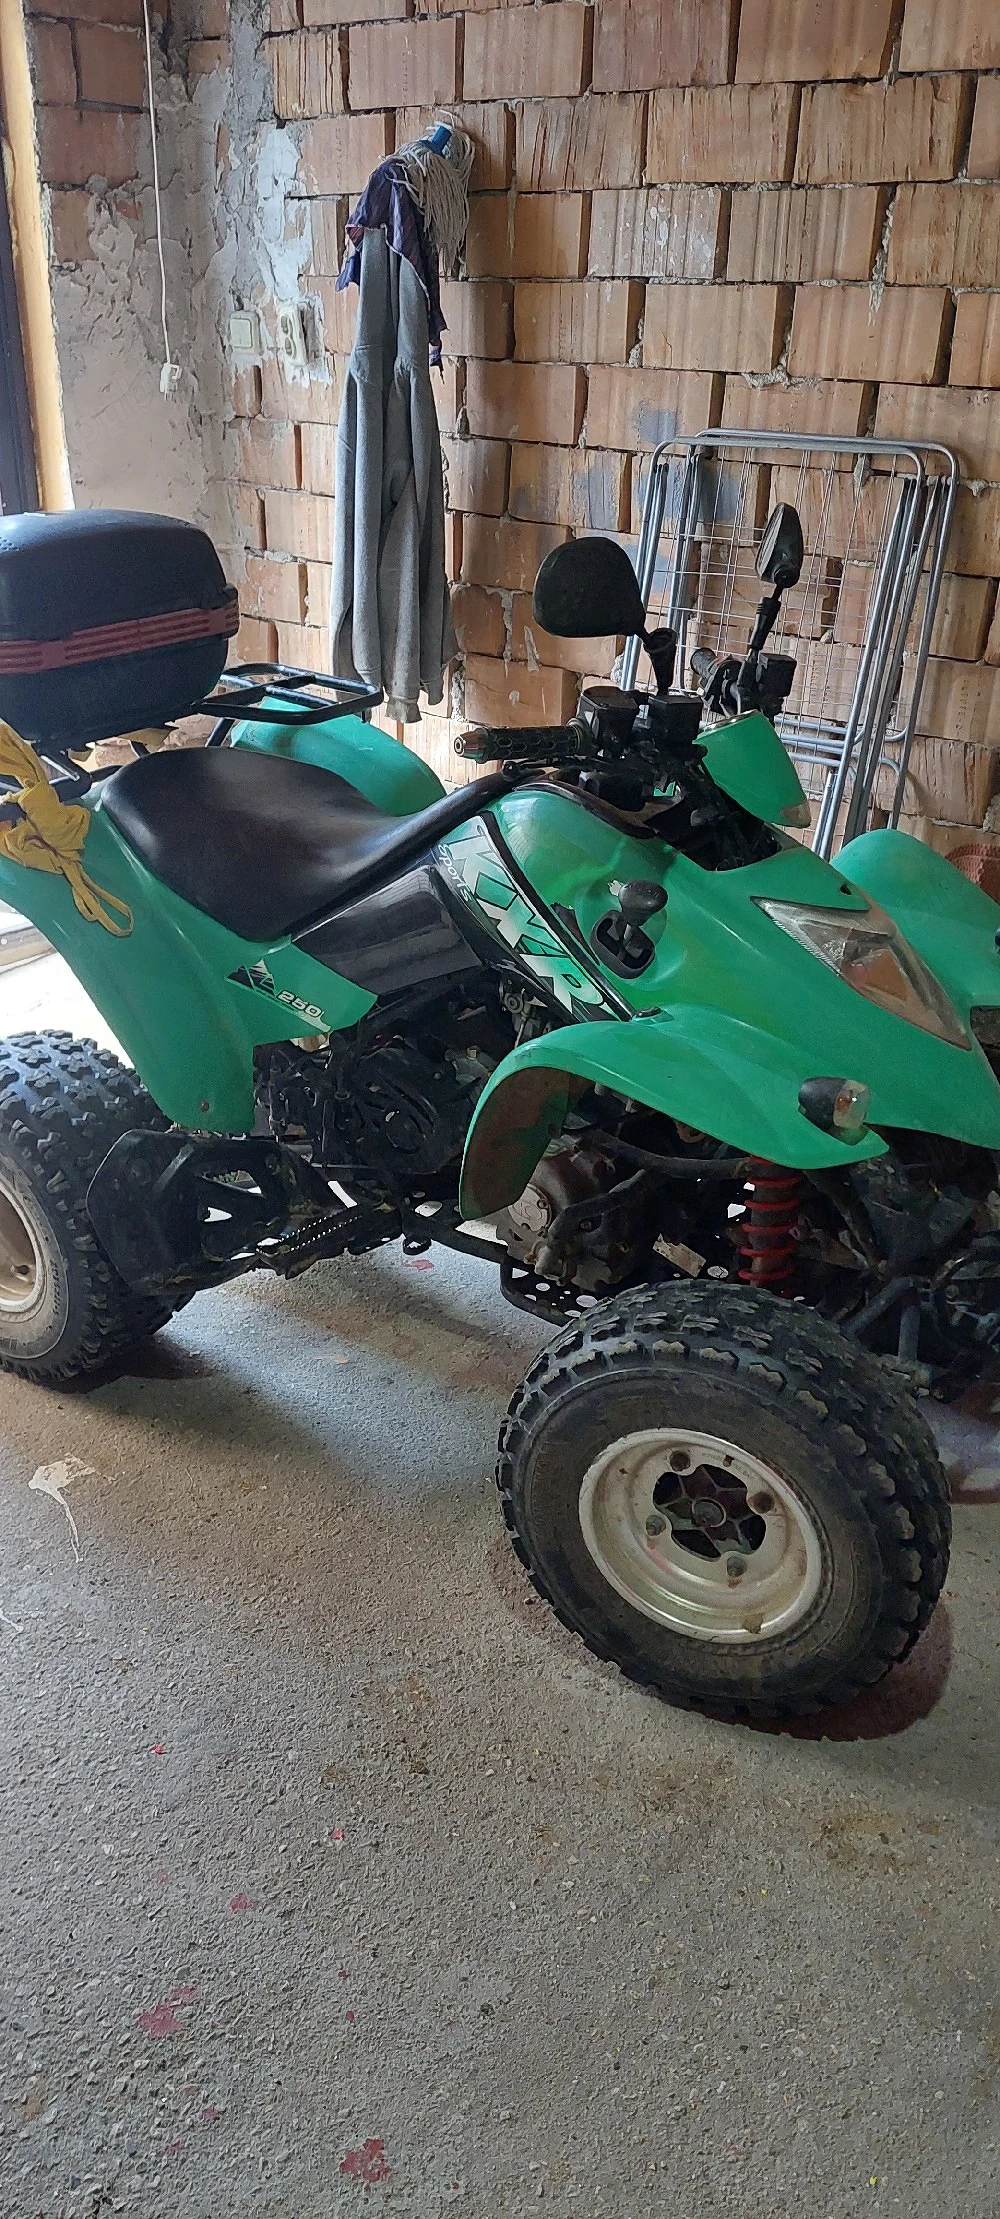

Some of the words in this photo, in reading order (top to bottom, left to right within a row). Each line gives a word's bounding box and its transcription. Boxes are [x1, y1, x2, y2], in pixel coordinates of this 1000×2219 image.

[438, 844, 472, 902] Sports
[446, 830, 605, 1014] KXR
[277, 990, 323, 1018] 250
